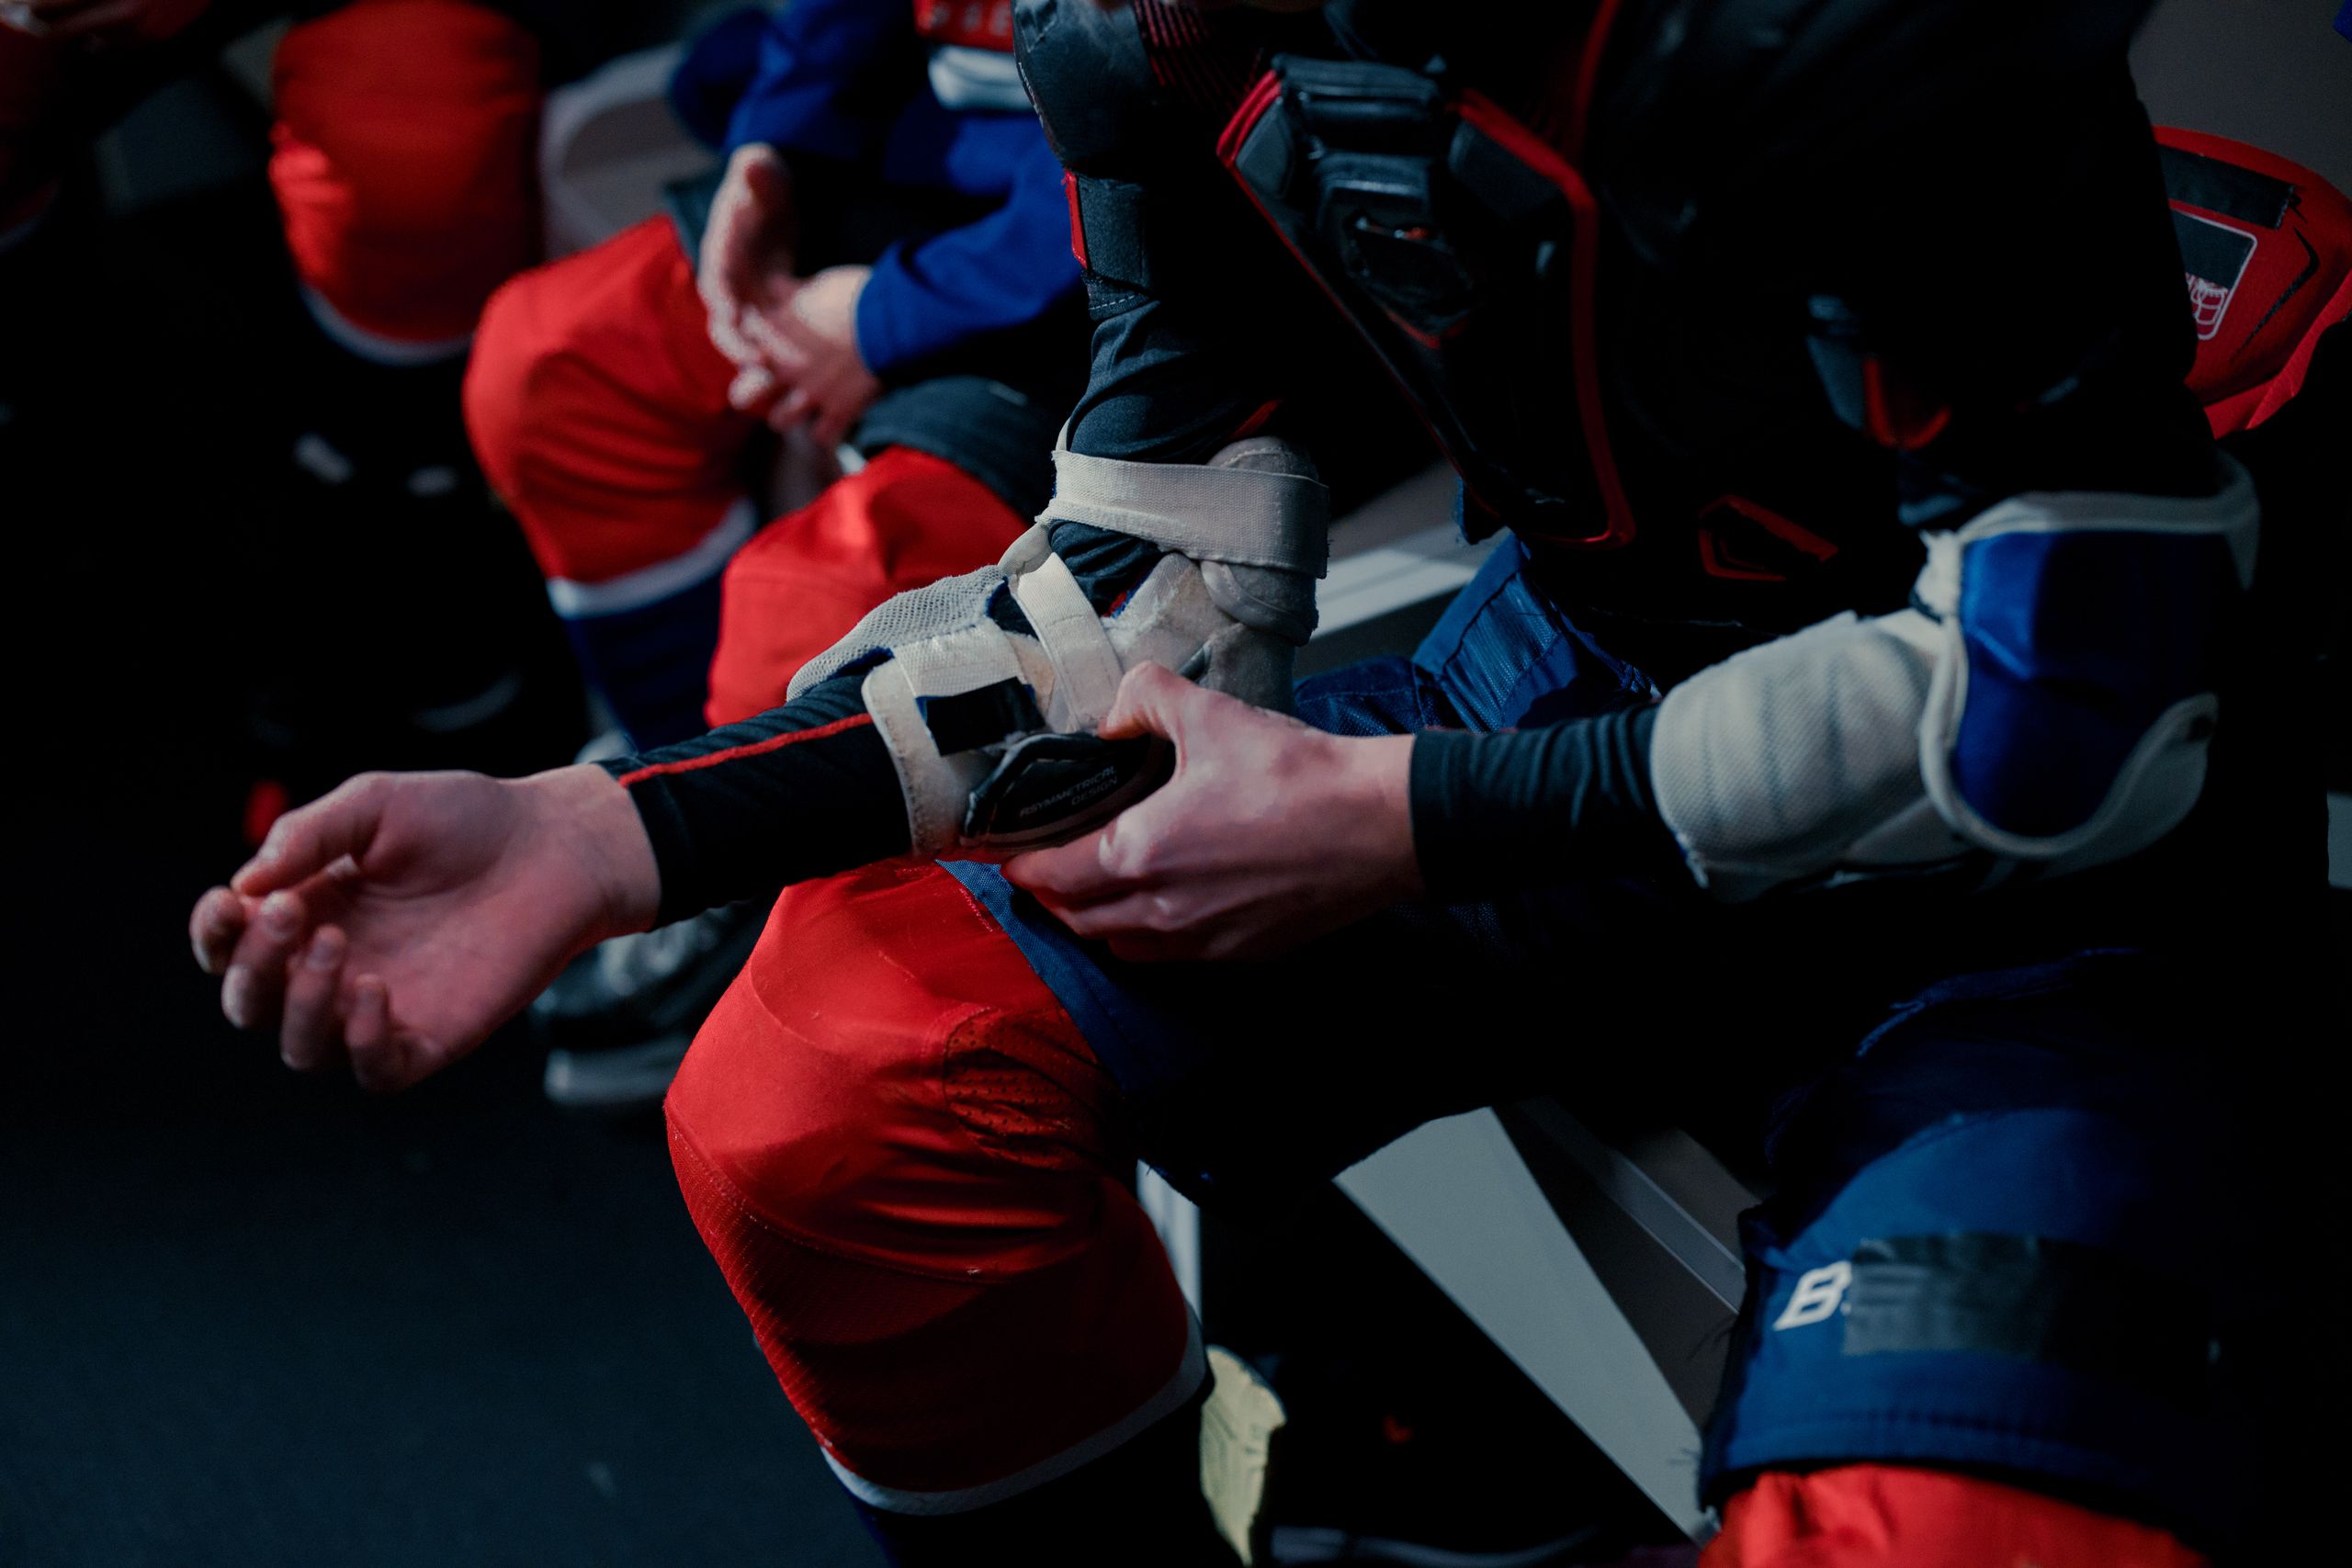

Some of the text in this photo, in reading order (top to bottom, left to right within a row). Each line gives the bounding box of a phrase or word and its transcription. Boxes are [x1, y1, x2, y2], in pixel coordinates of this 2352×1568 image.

[1019, 764, 1116, 818] ASYMMETRICAL
[1070, 775, 1118, 807] DESIGN
[1772, 1259, 1852, 1331] B
